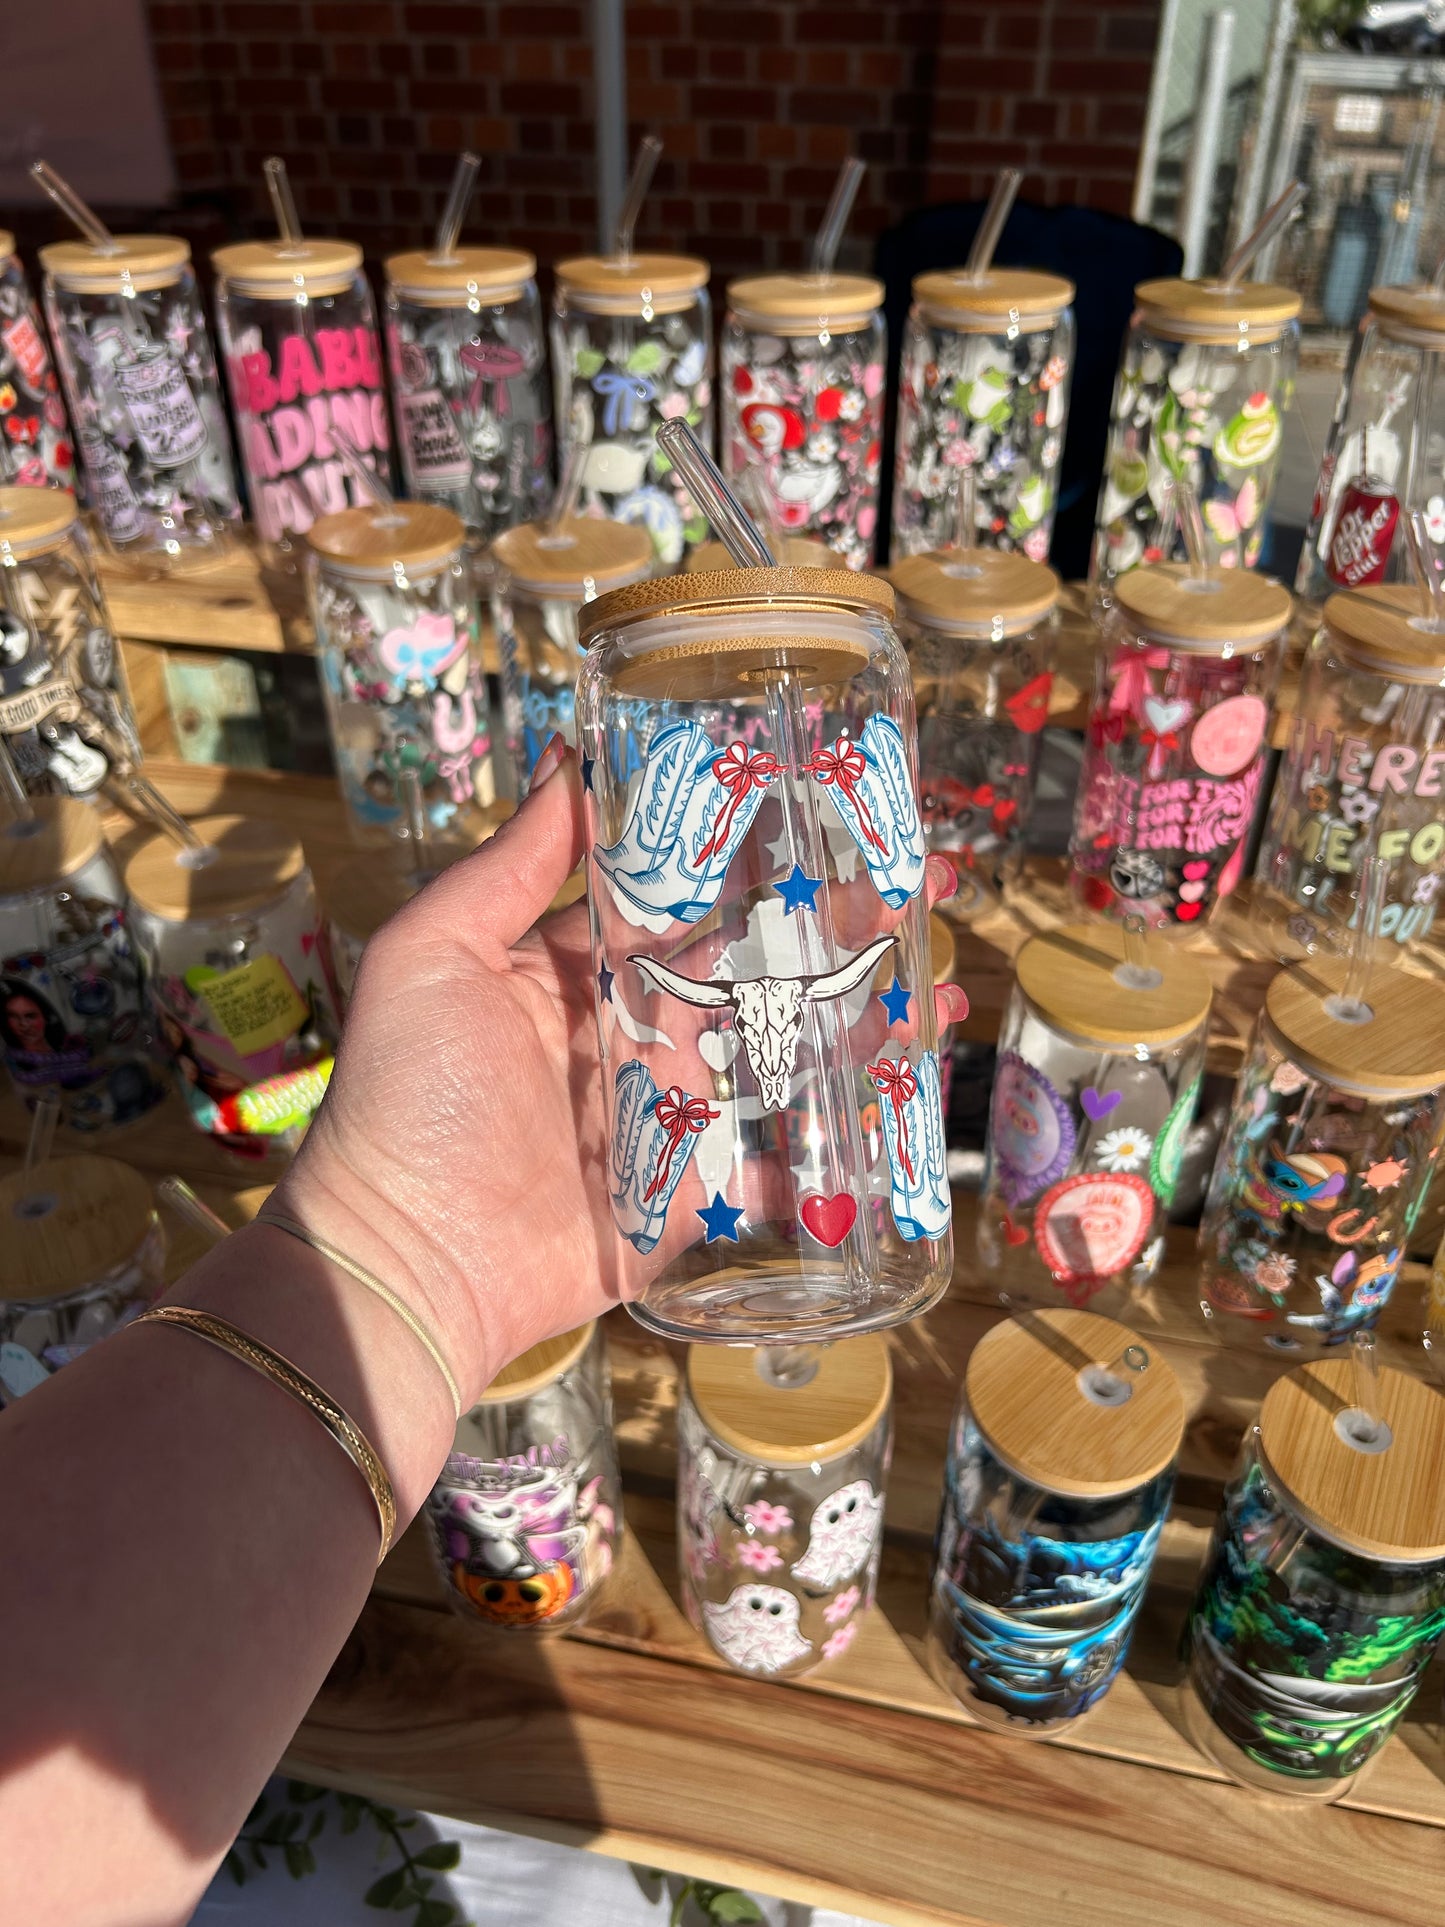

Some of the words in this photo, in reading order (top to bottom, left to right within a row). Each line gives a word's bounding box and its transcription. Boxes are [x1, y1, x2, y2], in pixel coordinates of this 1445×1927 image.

[1139, 778, 1191, 808] FOR
[1136, 801, 1185, 830] FOR
[1135, 824, 1183, 851] FOR
